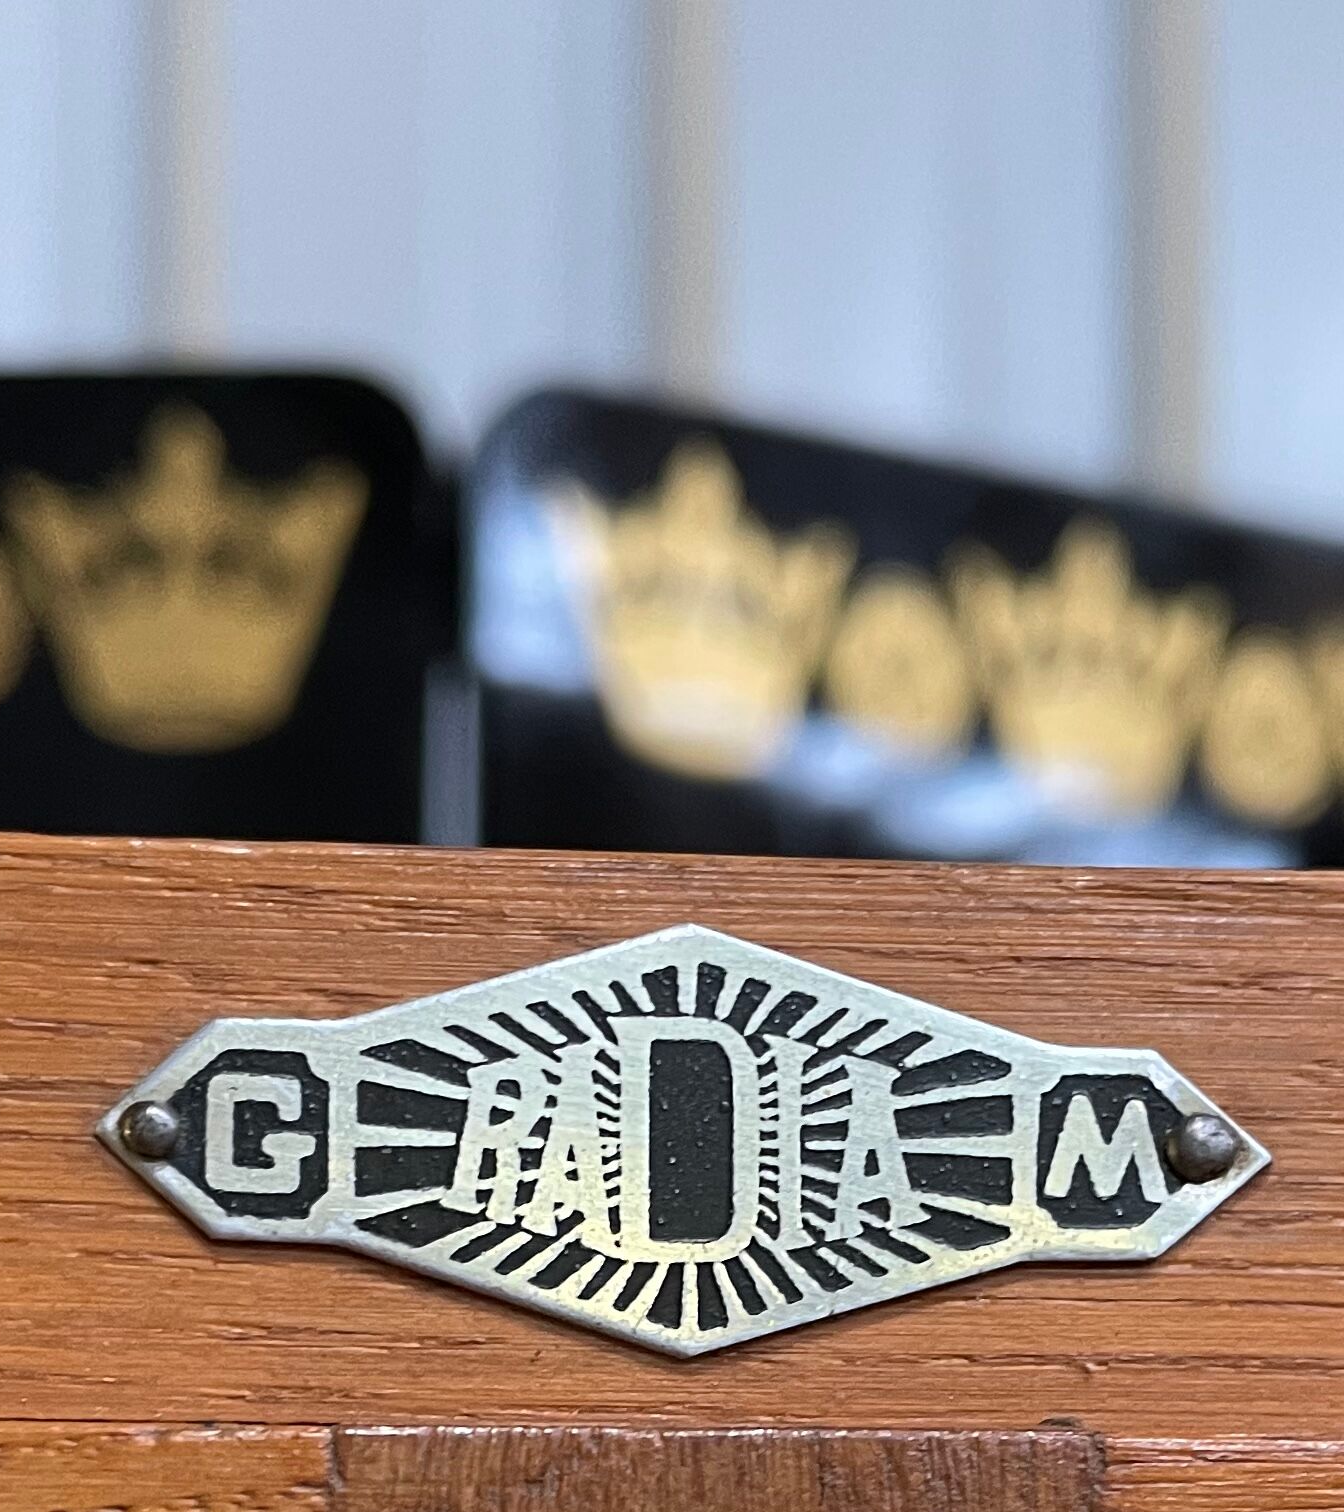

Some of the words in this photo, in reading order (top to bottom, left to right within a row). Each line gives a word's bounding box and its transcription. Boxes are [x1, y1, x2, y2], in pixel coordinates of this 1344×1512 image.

[204, 1073, 316, 1194] G
[441, 1017, 929, 1262] RADIA
[1044, 1094, 1166, 1202] M
